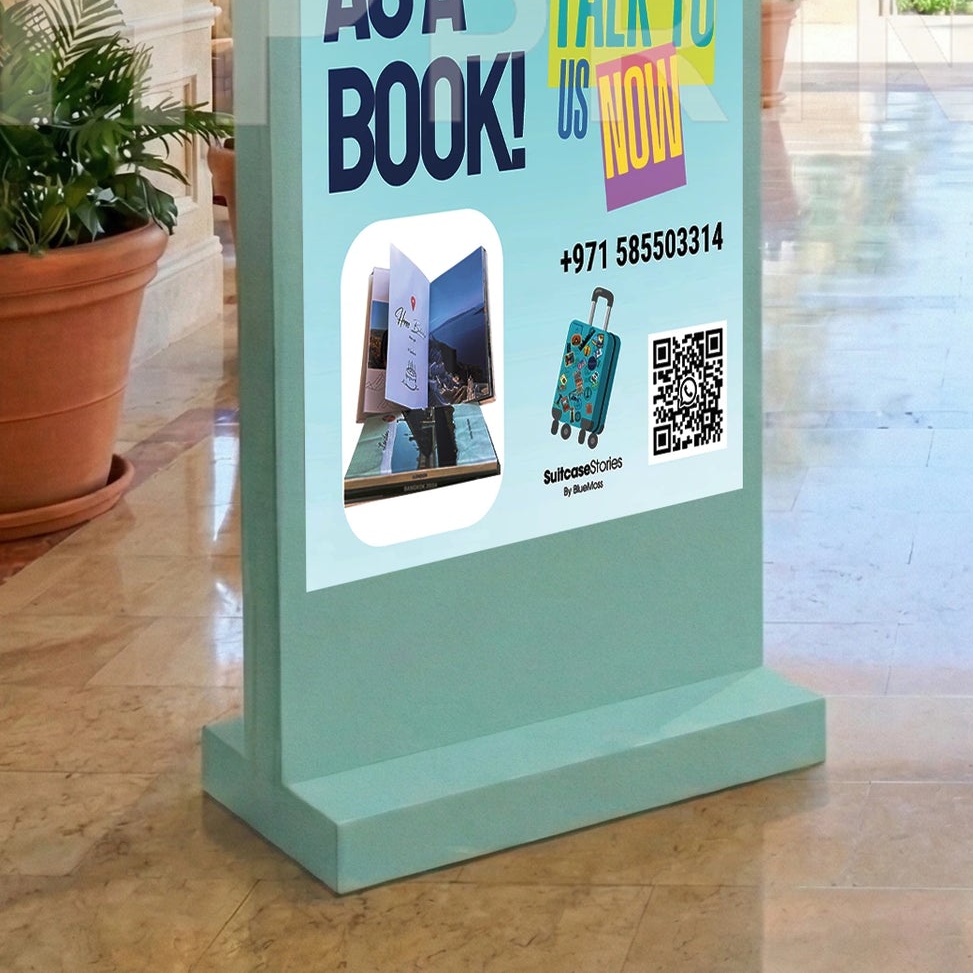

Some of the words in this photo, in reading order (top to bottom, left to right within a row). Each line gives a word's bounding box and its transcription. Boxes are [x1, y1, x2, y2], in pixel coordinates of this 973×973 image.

[328, 51, 526, 194] BOOK!
[558, 59, 589, 140] US
[598, 54, 683, 180] NOW
[560, 239, 607, 274] +971
[616, 221, 723, 267] 585503314
[543, 456, 623, 485] SuitcaseStories
[563, 486, 572, 497] By
[573, 480, 604, 494] BlueMoss
